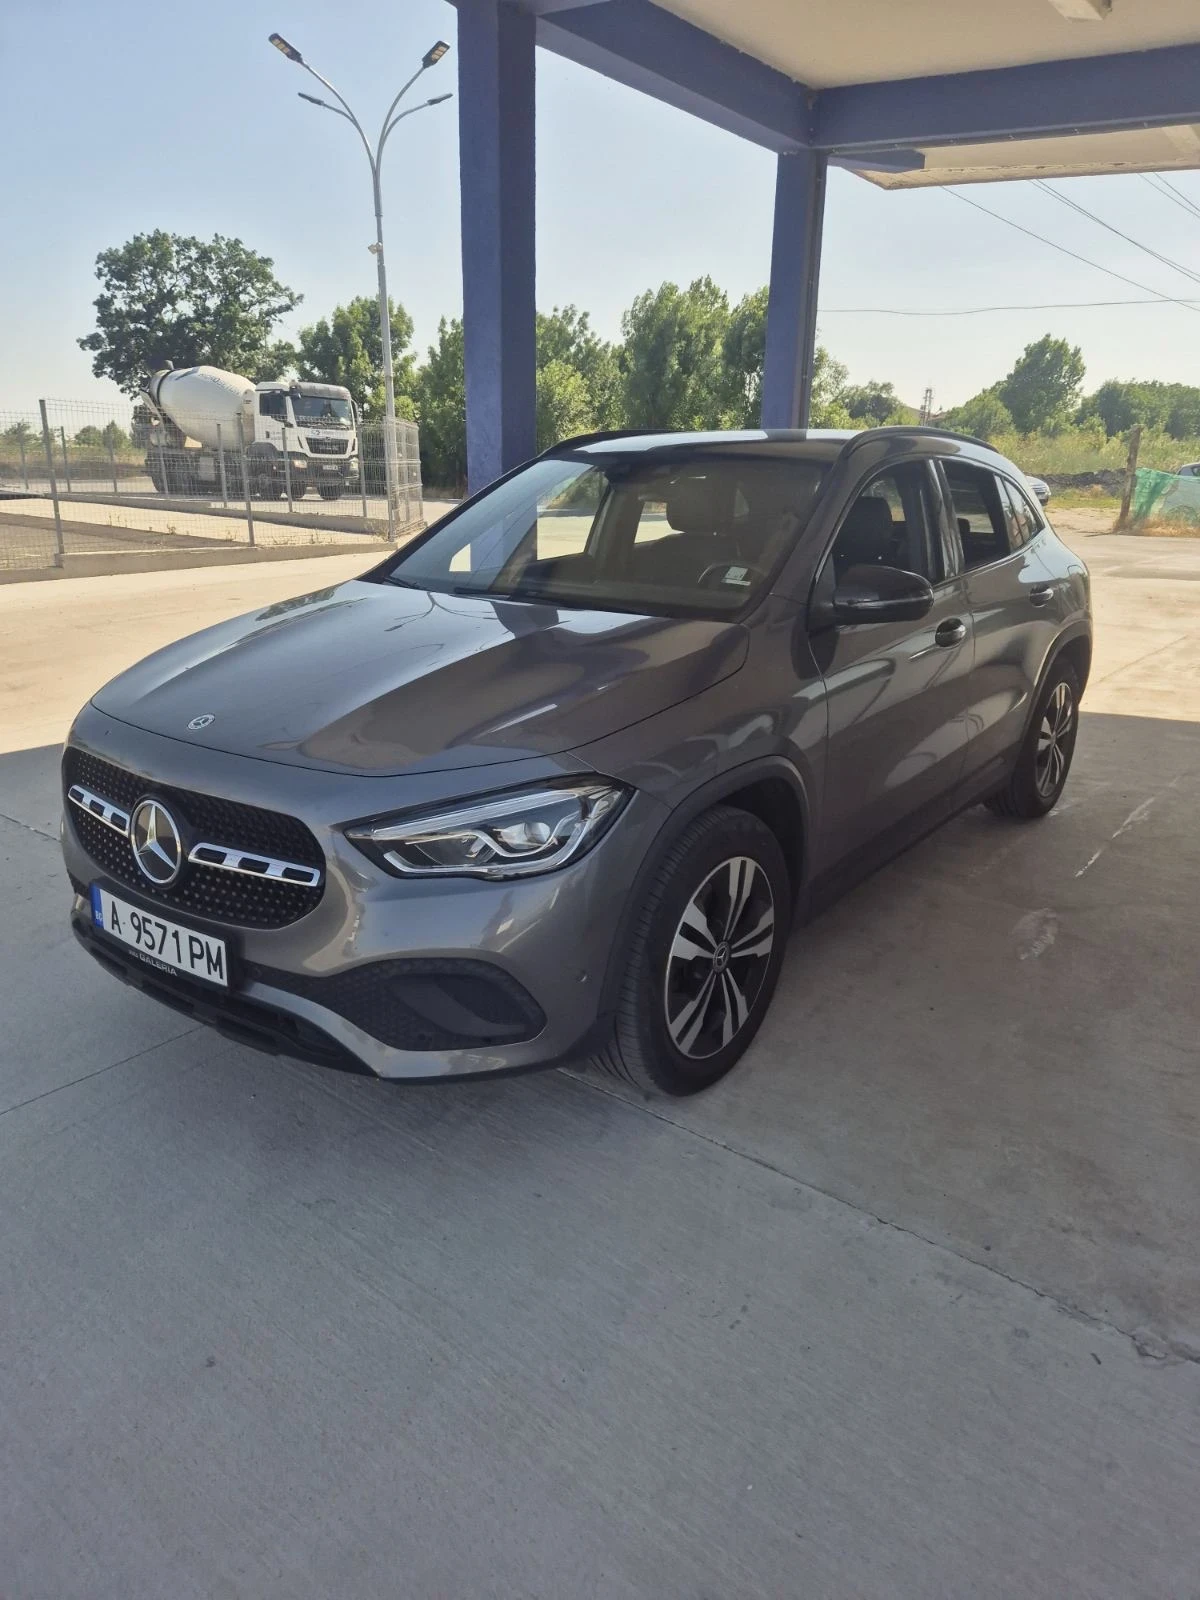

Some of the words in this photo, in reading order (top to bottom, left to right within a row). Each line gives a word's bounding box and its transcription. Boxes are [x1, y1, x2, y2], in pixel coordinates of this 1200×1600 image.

[111, 900, 122, 935] A
[130, 911, 182, 964] 9571
[188, 934, 223, 980] PM
